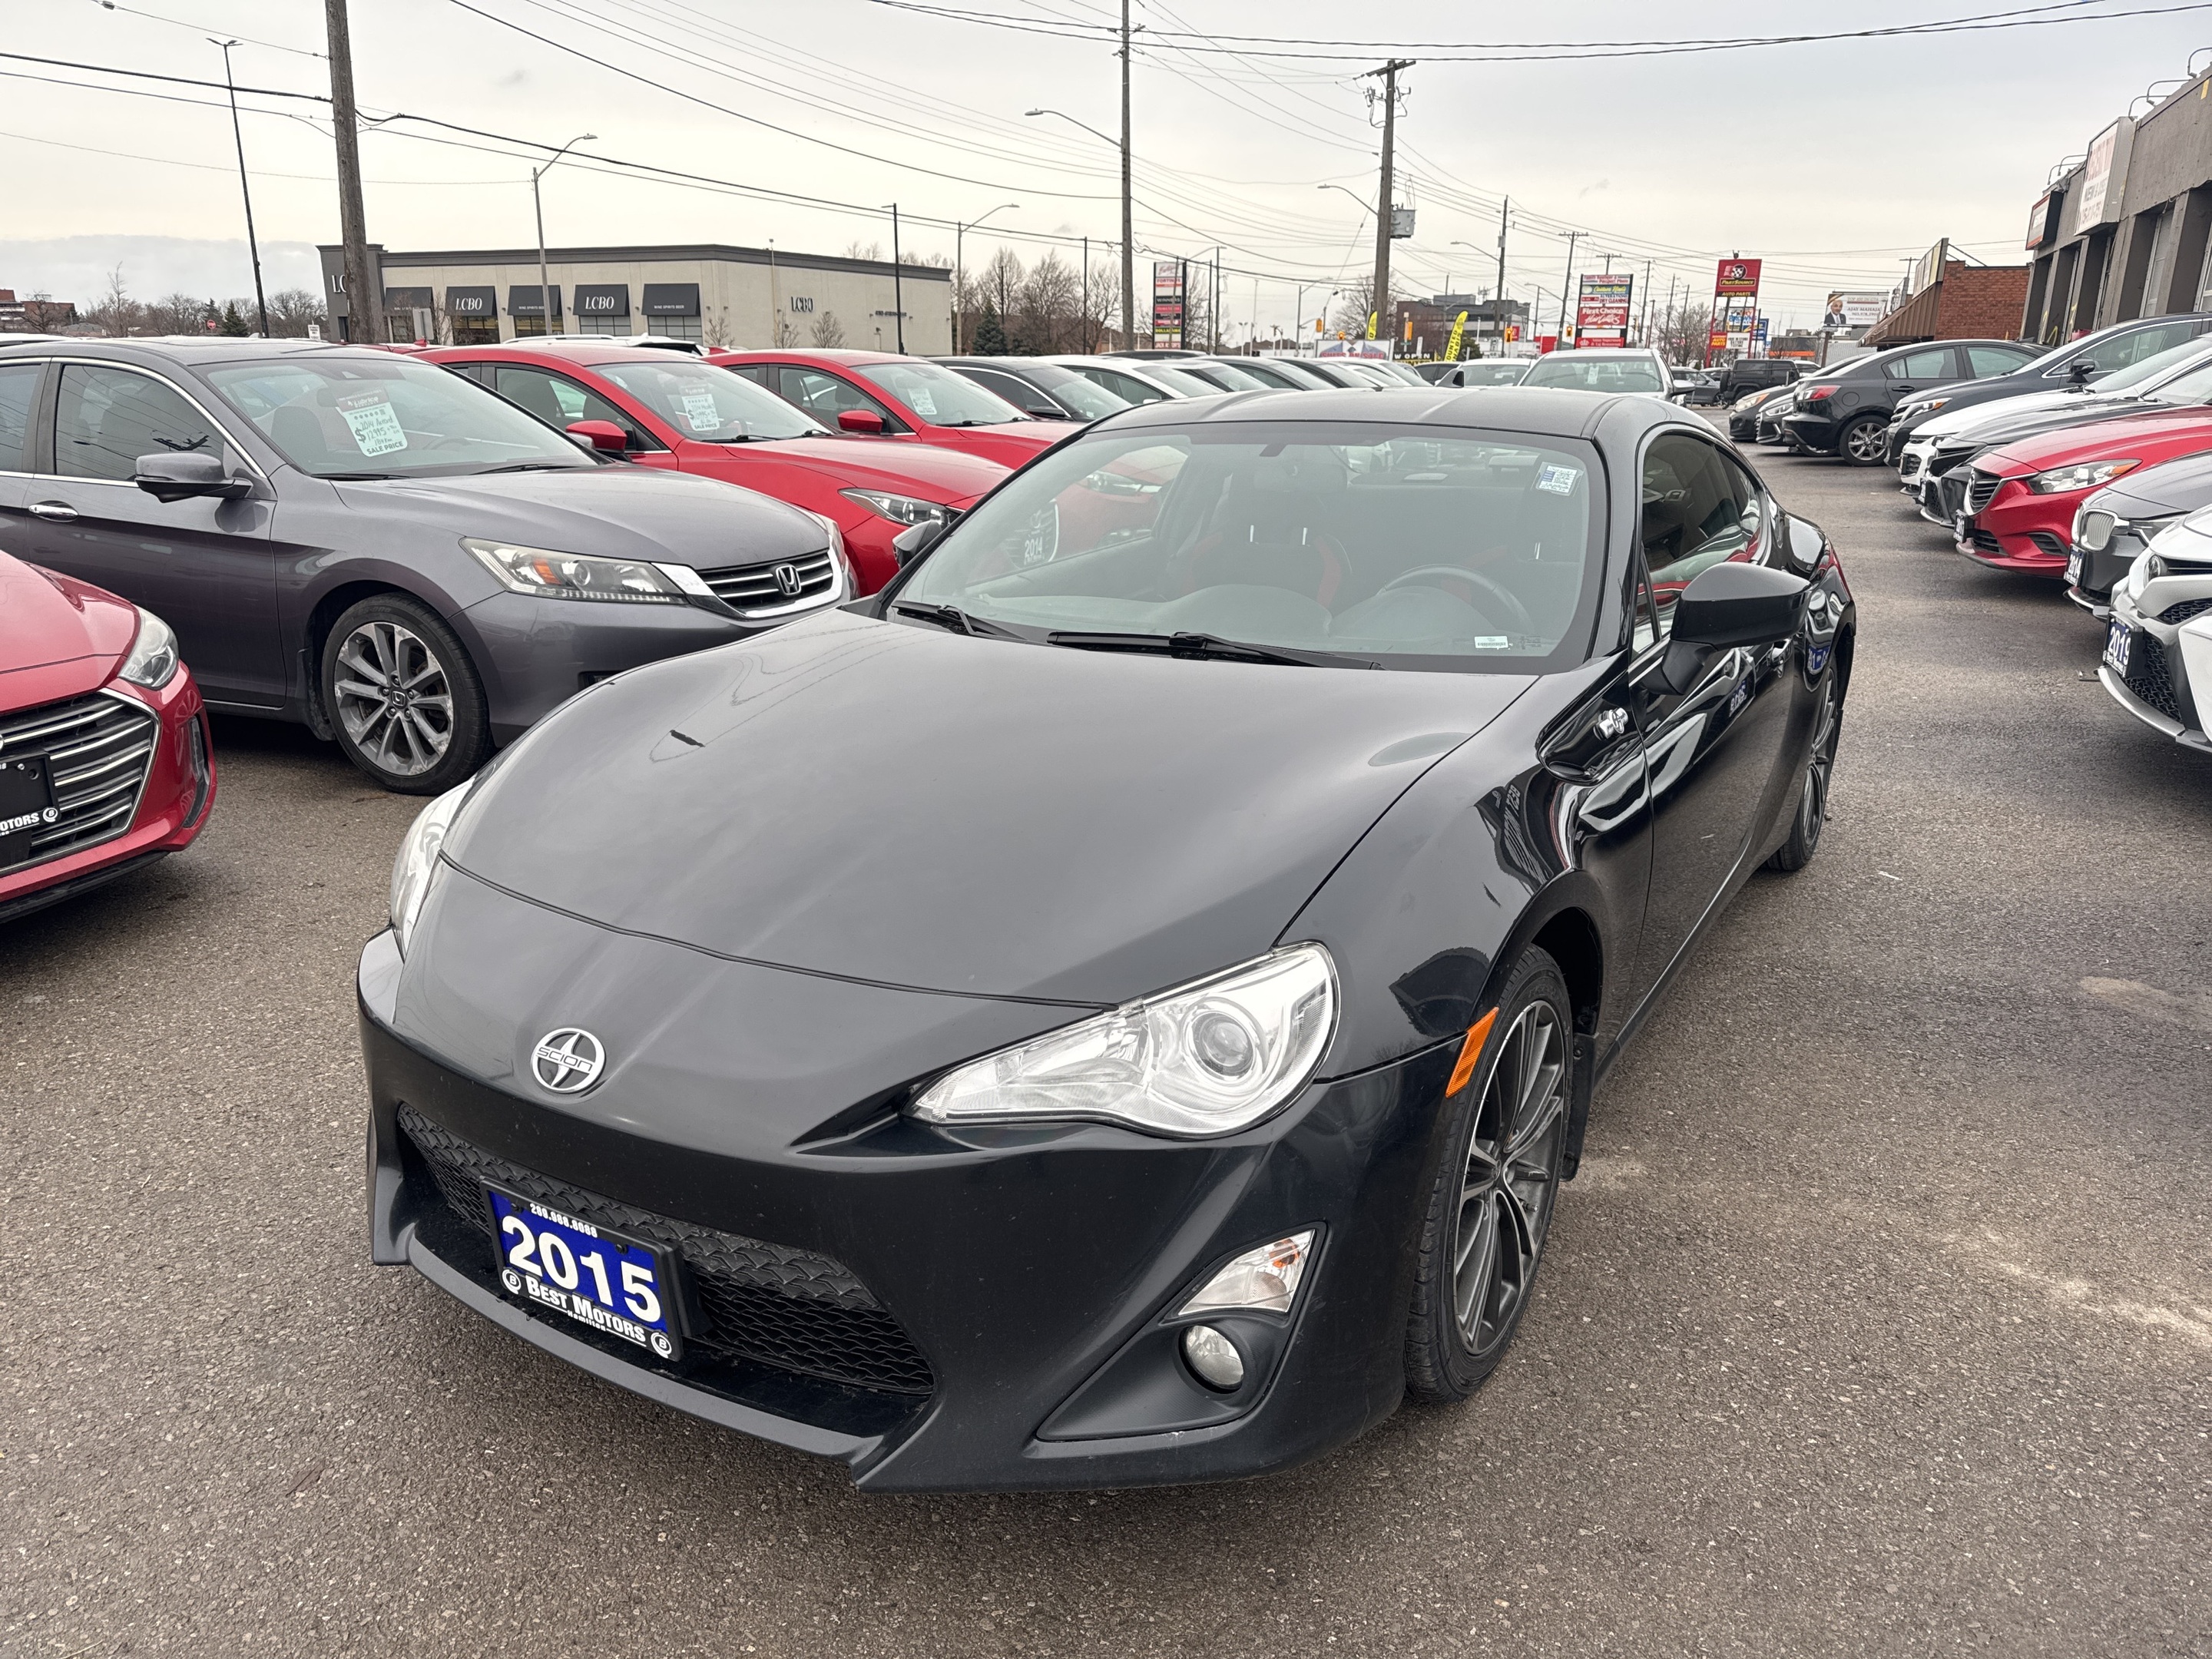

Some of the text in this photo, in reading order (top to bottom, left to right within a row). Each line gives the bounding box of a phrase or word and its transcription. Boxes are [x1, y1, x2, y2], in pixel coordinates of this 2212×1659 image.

[331, 274, 347, 293] LC
[455, 297, 482, 310] LCBO
[585, 296, 614, 310] LCBO
[790, 296, 813, 313] LCBO
[1446, 330, 1458, 360] OUNTED
[355, 427, 366, 443] $
[366, 441, 403, 455] SALE PRICE
[2108, 626, 2131, 665] 2019
[0, 813, 40, 831] OTORS
[537, 1047, 593, 1072] SCION
[502, 1215, 661, 1323] 2015
[525, 1274, 568, 1309] BEST
[571, 1294, 646, 1343] MOTORS
[567, 1310, 607, 1332] Hamilton
